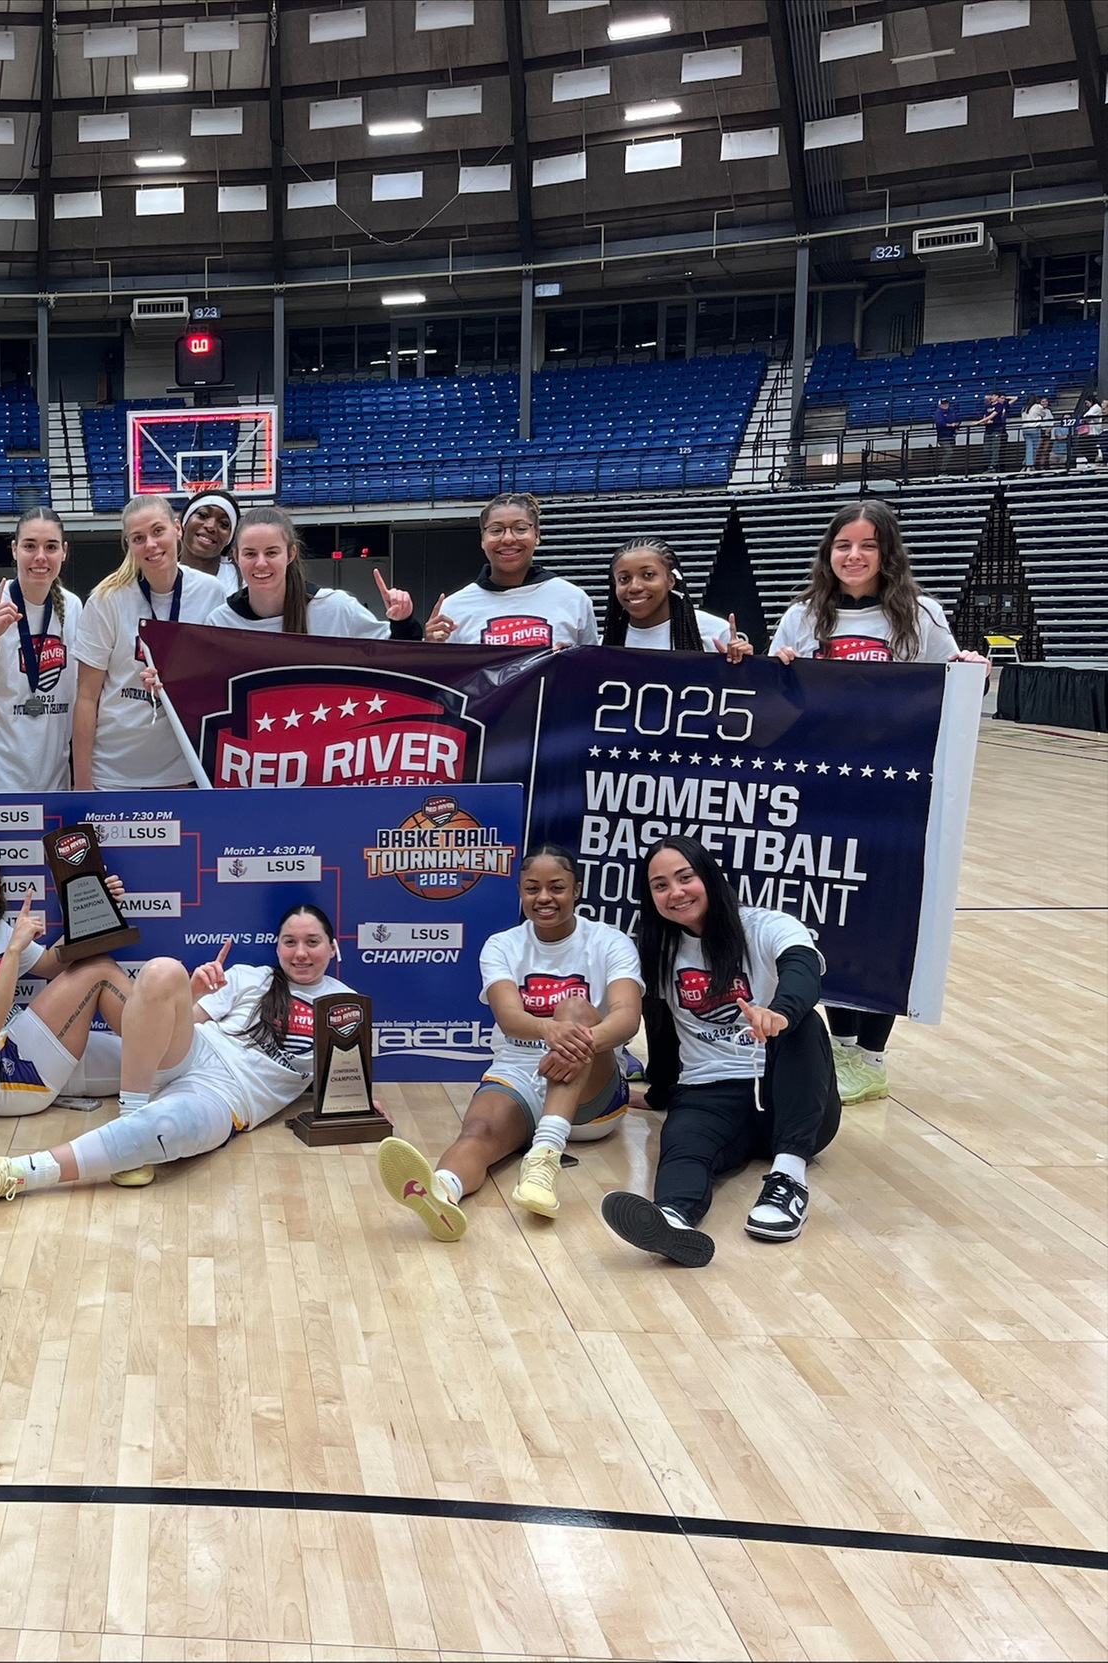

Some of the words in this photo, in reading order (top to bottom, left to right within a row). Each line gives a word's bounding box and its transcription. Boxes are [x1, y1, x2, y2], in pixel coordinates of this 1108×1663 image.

[875, 244, 901, 259] 325
[194, 306, 218, 319] 323
[1062, 418, 1077, 427] 127
[484, 634, 509, 645] RED
[512, 627, 549, 641] RIVER
[40, 647, 65, 662] RIVER
[35, 694, 55, 703] 2025
[593, 680, 757, 742] 2025
[221, 742, 308, 788] RED
[322, 732, 459, 784] RIVER
[585, 770, 800, 828] WOMEN'S
[438, 802, 455, 811] RIVER
[85, 812, 116, 821] March
[118, 812, 124, 820] 1
[132, 811, 154, 820] 7:30
[155, 811, 173, 820] PM
[129, 827, 167, 839] LSUS
[378, 828, 502, 848] BASKETBALL
[70, 838, 87, 850] RIVER
[580, 815, 868, 882] BASETBALL
[223, 846, 256, 856] March
[257, 846, 266, 855] 2
[272, 846, 296, 855] 4:30
[298, 845, 316, 855] PM
[267, 860, 306, 872] LSUS
[366, 848, 513, 875] TOURNAMENT
[419, 873, 458, 886] 2025
[72, 899, 105, 912] CHAMPIONS
[119, 899, 172, 911] AMUSA
[184, 933, 252, 945] WOMEN'S
[411, 928, 450, 940] LSUS
[361, 950, 460, 964] CHAMPION
[521, 993, 545, 1007] RED
[548, 987, 587, 1006] RIVER
[680, 988, 702, 1001] RED
[294, 1015, 314, 1026] RIV
[342, 1010, 361, 1021] RIVER
[90, 1020, 111, 1030] Mar
[393, 1020, 415, 1028] Economic
[416, 1020, 448, 1029] Development
[448, 1020, 470, 1029] Authority
[712, 1025, 741, 1037] 2025
[330, 1075, 362, 1083] CHAMPIONS
